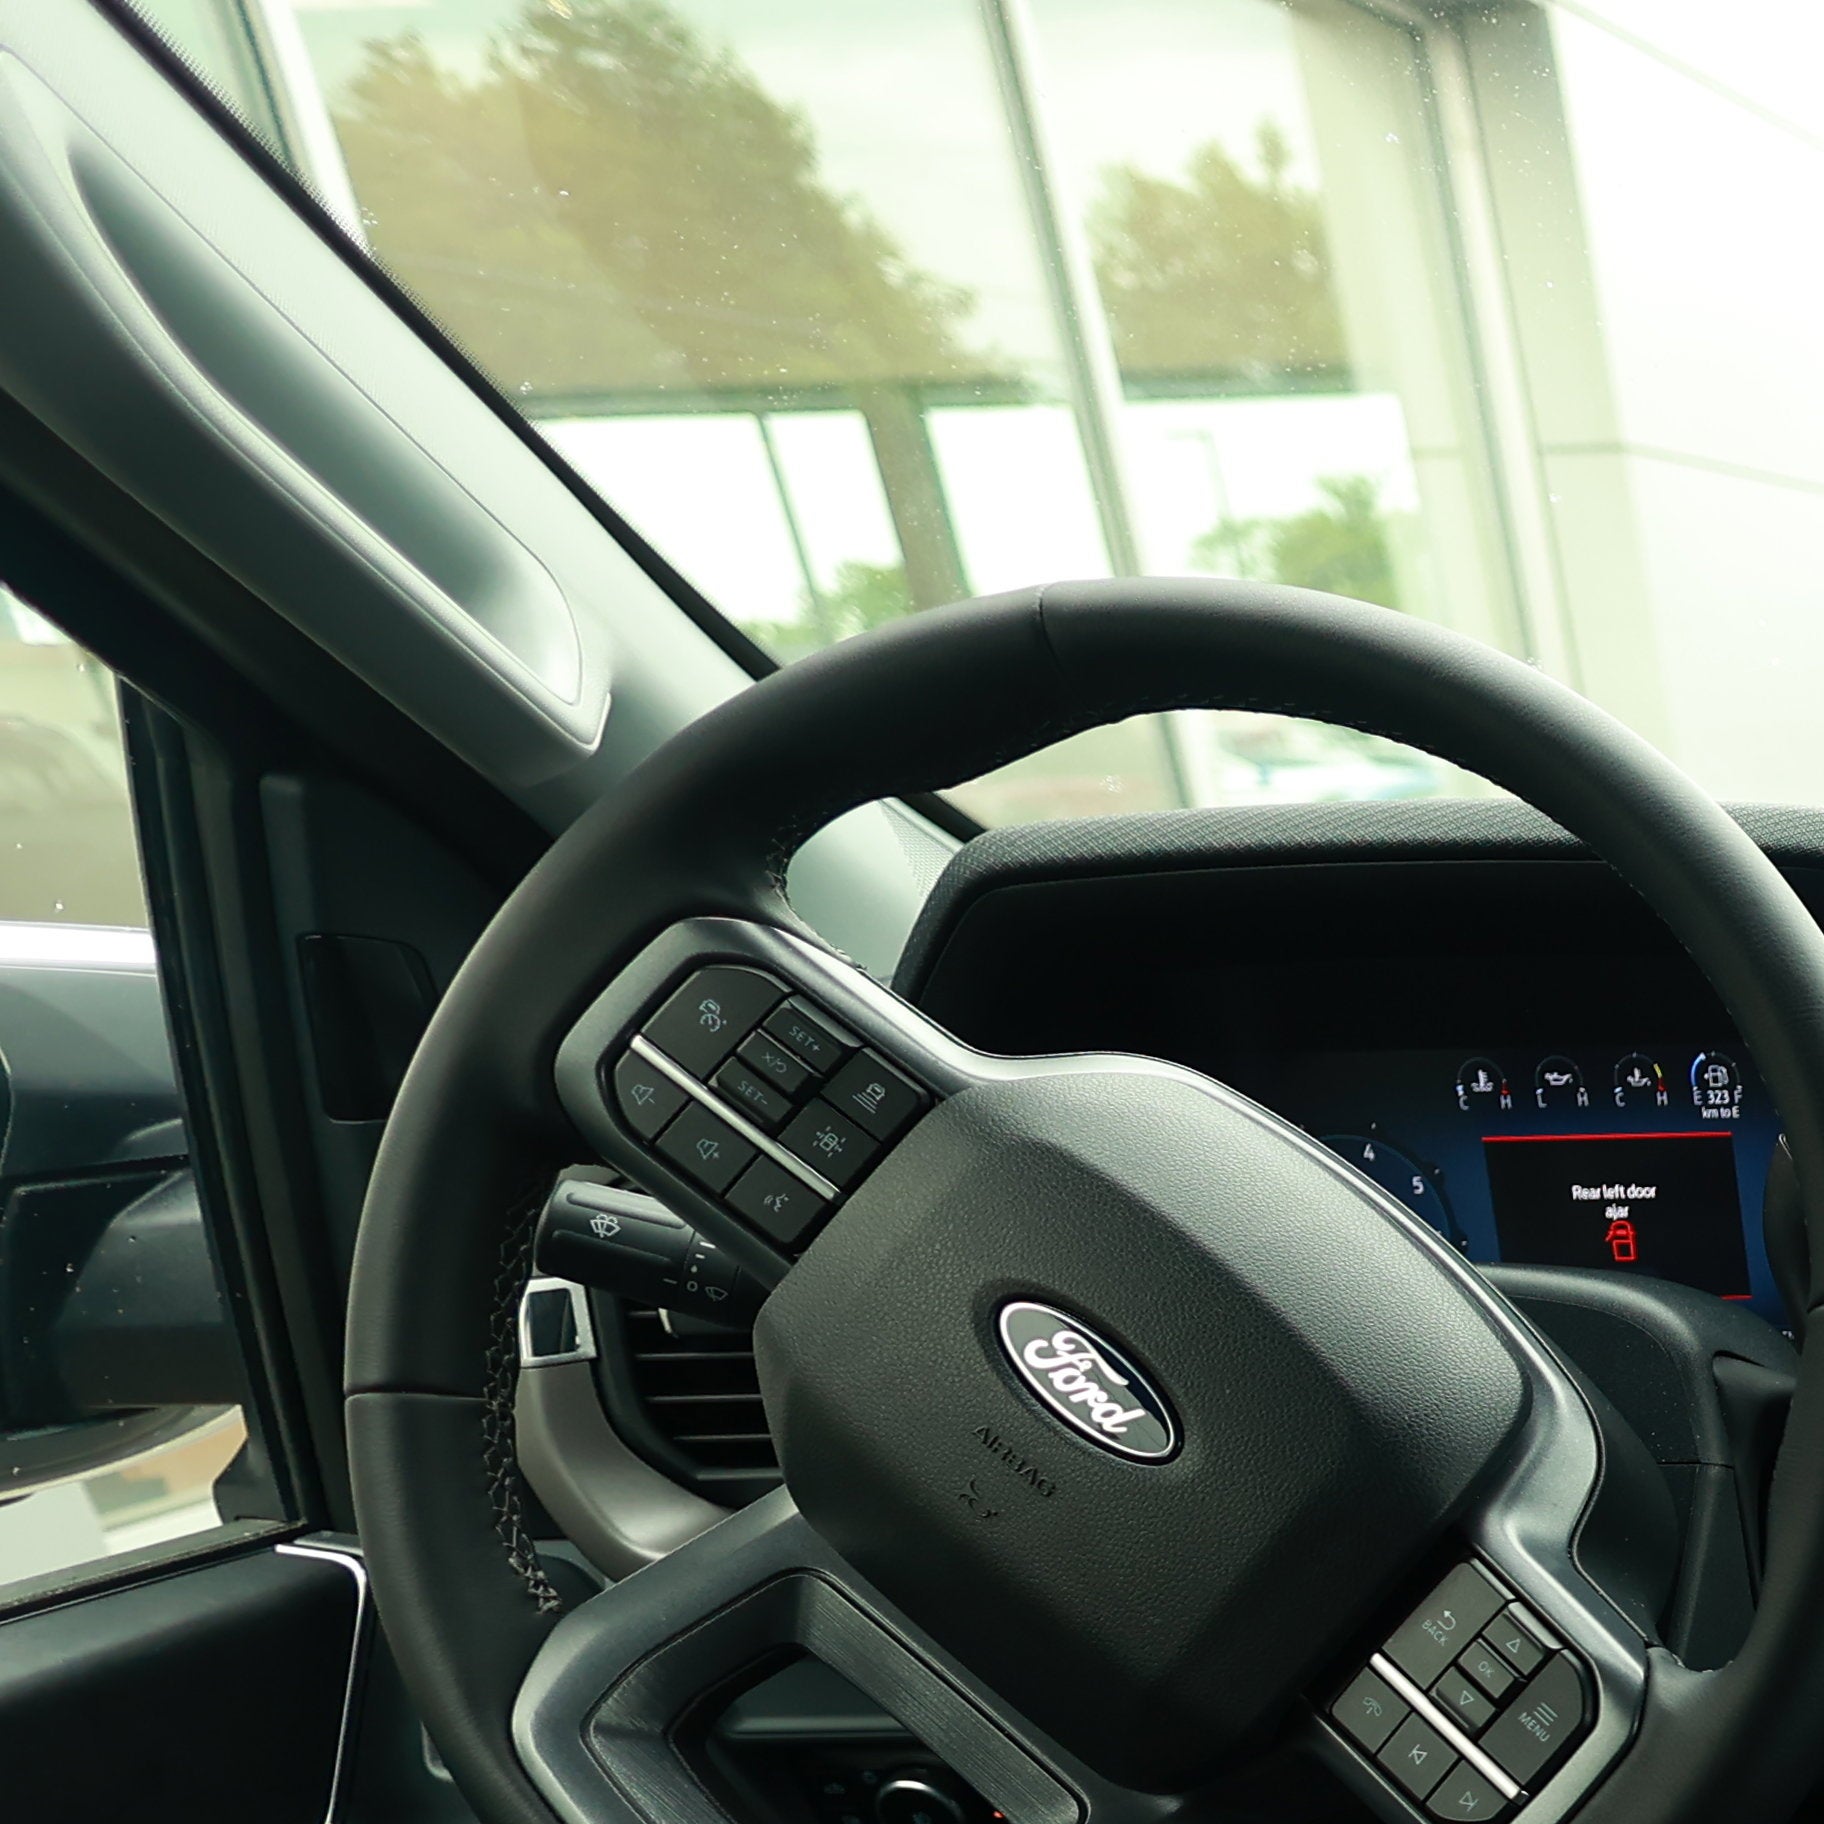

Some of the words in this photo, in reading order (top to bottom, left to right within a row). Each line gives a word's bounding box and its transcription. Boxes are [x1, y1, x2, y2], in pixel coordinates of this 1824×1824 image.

[1707, 1090, 1730, 1104] 323
[1701, 1106, 1719, 1119] km
[1719, 1106, 1731, 1119] to
[1732, 1105, 1740, 1119] E
[1363, 1143, 1376, 1162] 4
[1412, 1176, 1425, 1195] 5
[1572, 1185, 1601, 1201] Rear
[1602, 1184, 1626, 1200] left
[1627, 1184, 1656, 1199] door
[1605, 1204, 1629, 1220] ajar
[1023, 1330, 1146, 1434] Ford
[972, 1425, 1056, 1498] AIRBAG
[1421, 1619, 1449, 1647] BACK
[1478, 1660, 1495, 1678] OK
[1518, 1712, 1550, 1743] MENU
